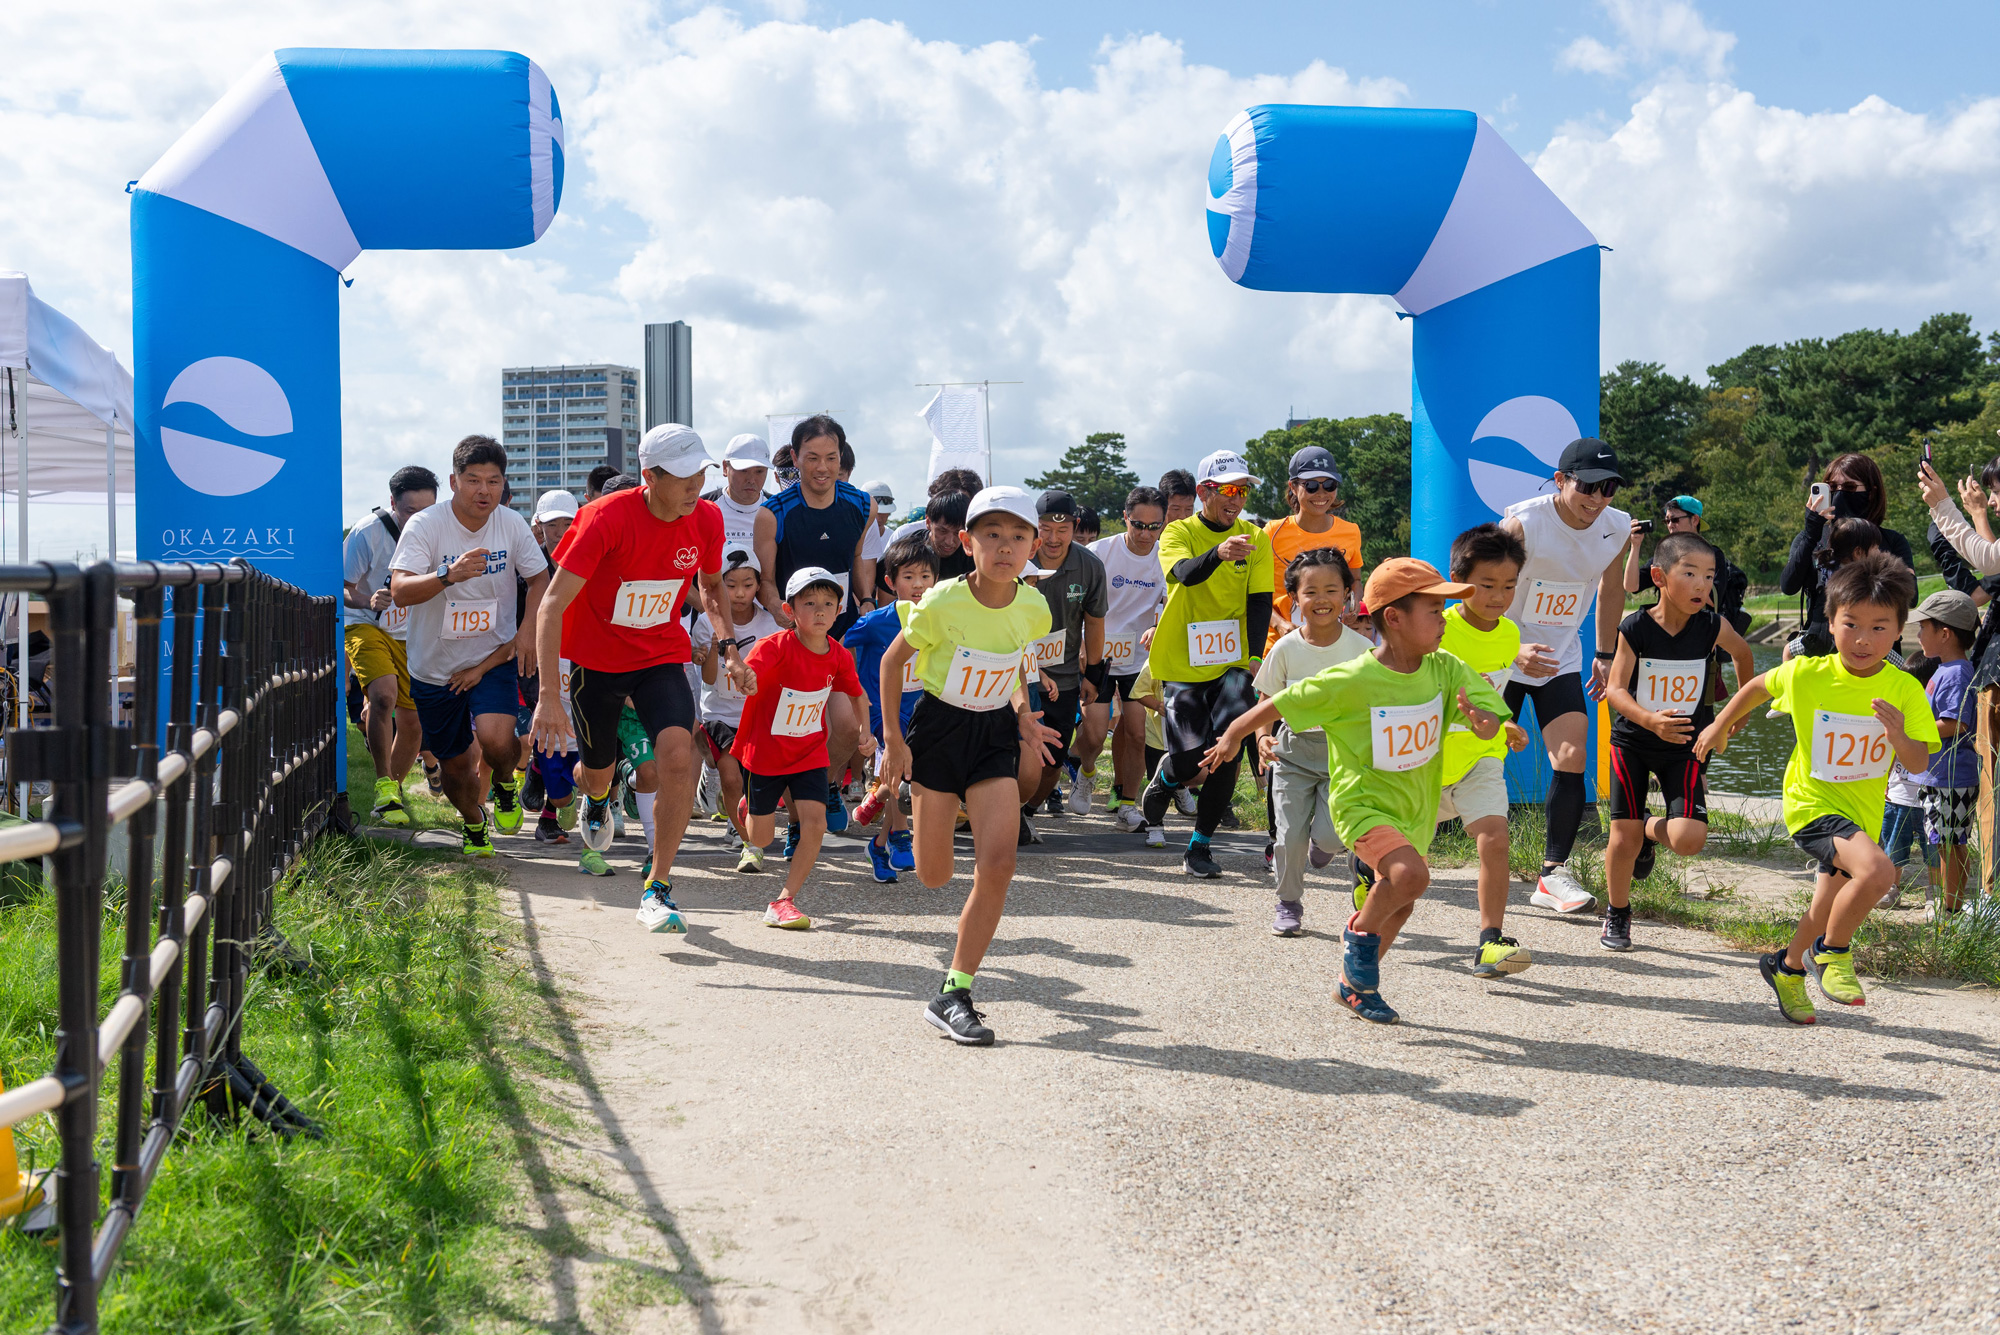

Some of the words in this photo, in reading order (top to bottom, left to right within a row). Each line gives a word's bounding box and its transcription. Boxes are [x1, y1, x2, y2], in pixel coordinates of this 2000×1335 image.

[162, 528, 295, 546] OKAZAKI
[1133, 579, 1156, 588] MONDE
[626, 591, 672, 618] 1178
[1535, 592, 1578, 616] 1182
[385, 606, 407, 627] 119
[451, 611, 490, 632] 1193
[1036, 640, 1063, 661] 200
[1104, 641, 1131, 659] 205
[1195, 632, 1236, 655] 1216
[960, 666, 1017, 698] 1177
[1648, 675, 1698, 703] 1182
[786, 700, 823, 727] 1178
[1383, 714, 1438, 758] 1202
[1824, 731, 1886, 767] 1216
[943, 1004, 966, 1024] N
